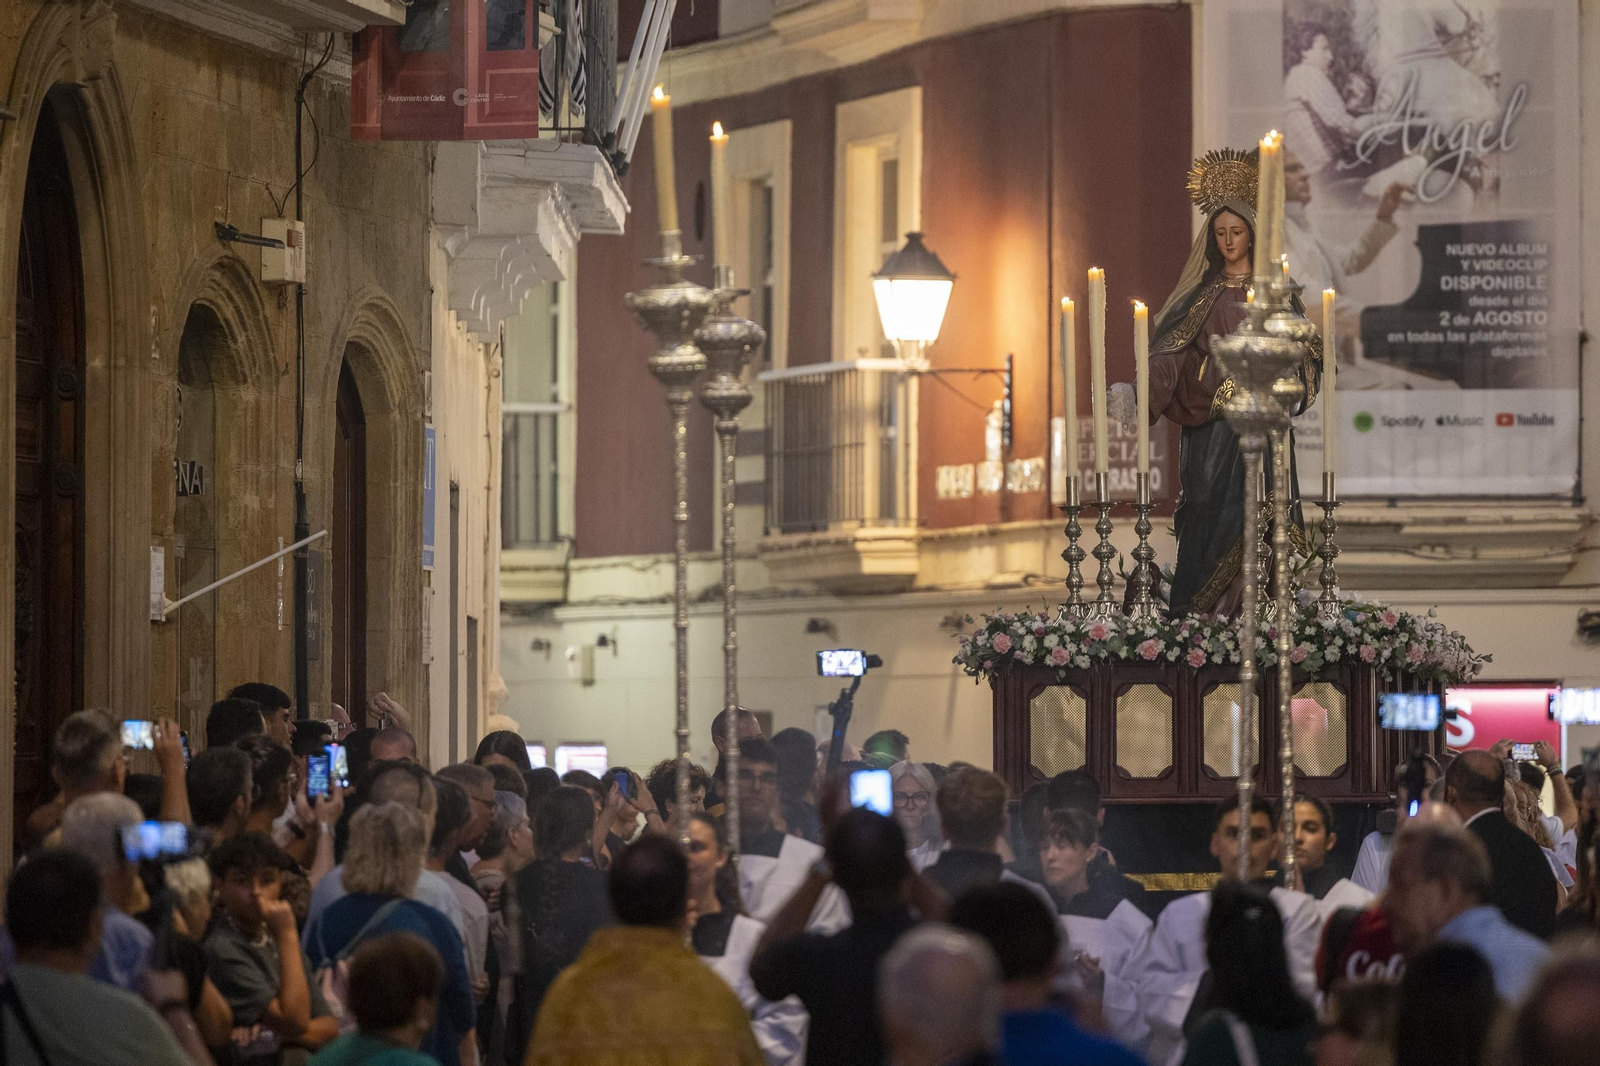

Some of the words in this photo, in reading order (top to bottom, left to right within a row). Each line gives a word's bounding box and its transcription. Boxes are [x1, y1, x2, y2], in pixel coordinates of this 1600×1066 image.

[388, 94, 422, 104] Ayuntamiento
[430, 94, 446, 102] Cádiz
[1446, 243, 1496, 256] NUEVO
[1460, 259, 1471, 271] Y
[1472, 259, 1547, 271] VIDEOCLIP
[1440, 275, 1546, 291] DISPONIBLE
[1468, 294, 1509, 307] desde
[1512, 294, 1525, 307] el
[1439, 311, 1451, 327] 2
[1453, 314, 1471, 327] de
[1472, 311, 1548, 327] AGOSTO
[1387, 332, 1405, 343] en
[1406, 330, 1445, 343] todas
[1446, 330, 1467, 343] las
[1468, 330, 1547, 345] plataformas
[1380, 414, 1426, 429] Spotify
[1445, 415, 1484, 427] Music
[1517, 413, 1556, 427] YouTube
